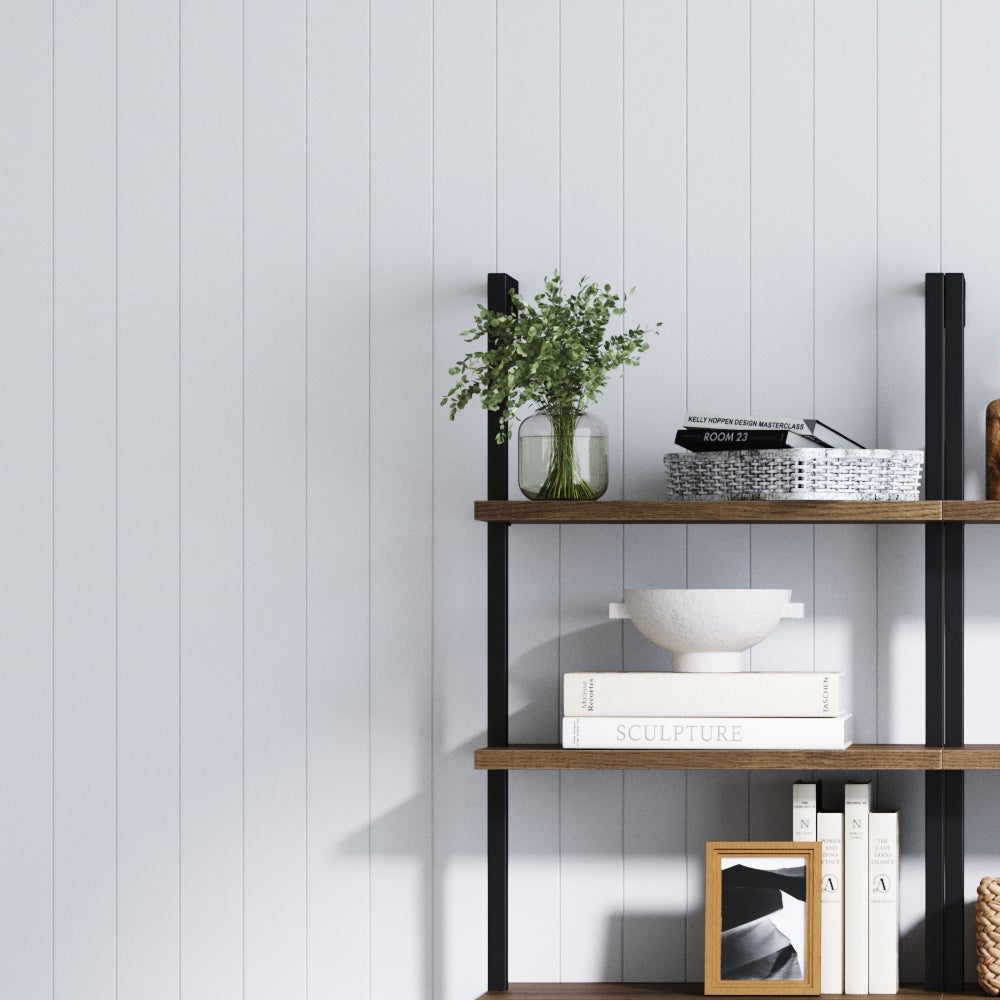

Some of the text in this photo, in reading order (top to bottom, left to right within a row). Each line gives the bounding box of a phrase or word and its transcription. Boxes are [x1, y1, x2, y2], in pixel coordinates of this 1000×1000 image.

[687, 416, 805, 431] KELLY HOPPEN DESIGN MASTERCLASS
[703, 432, 748, 442] ROOM 23
[616, 724, 743, 742] SCULPTURE
[800, 818, 809, 828] N
[852, 818, 861, 828] N
